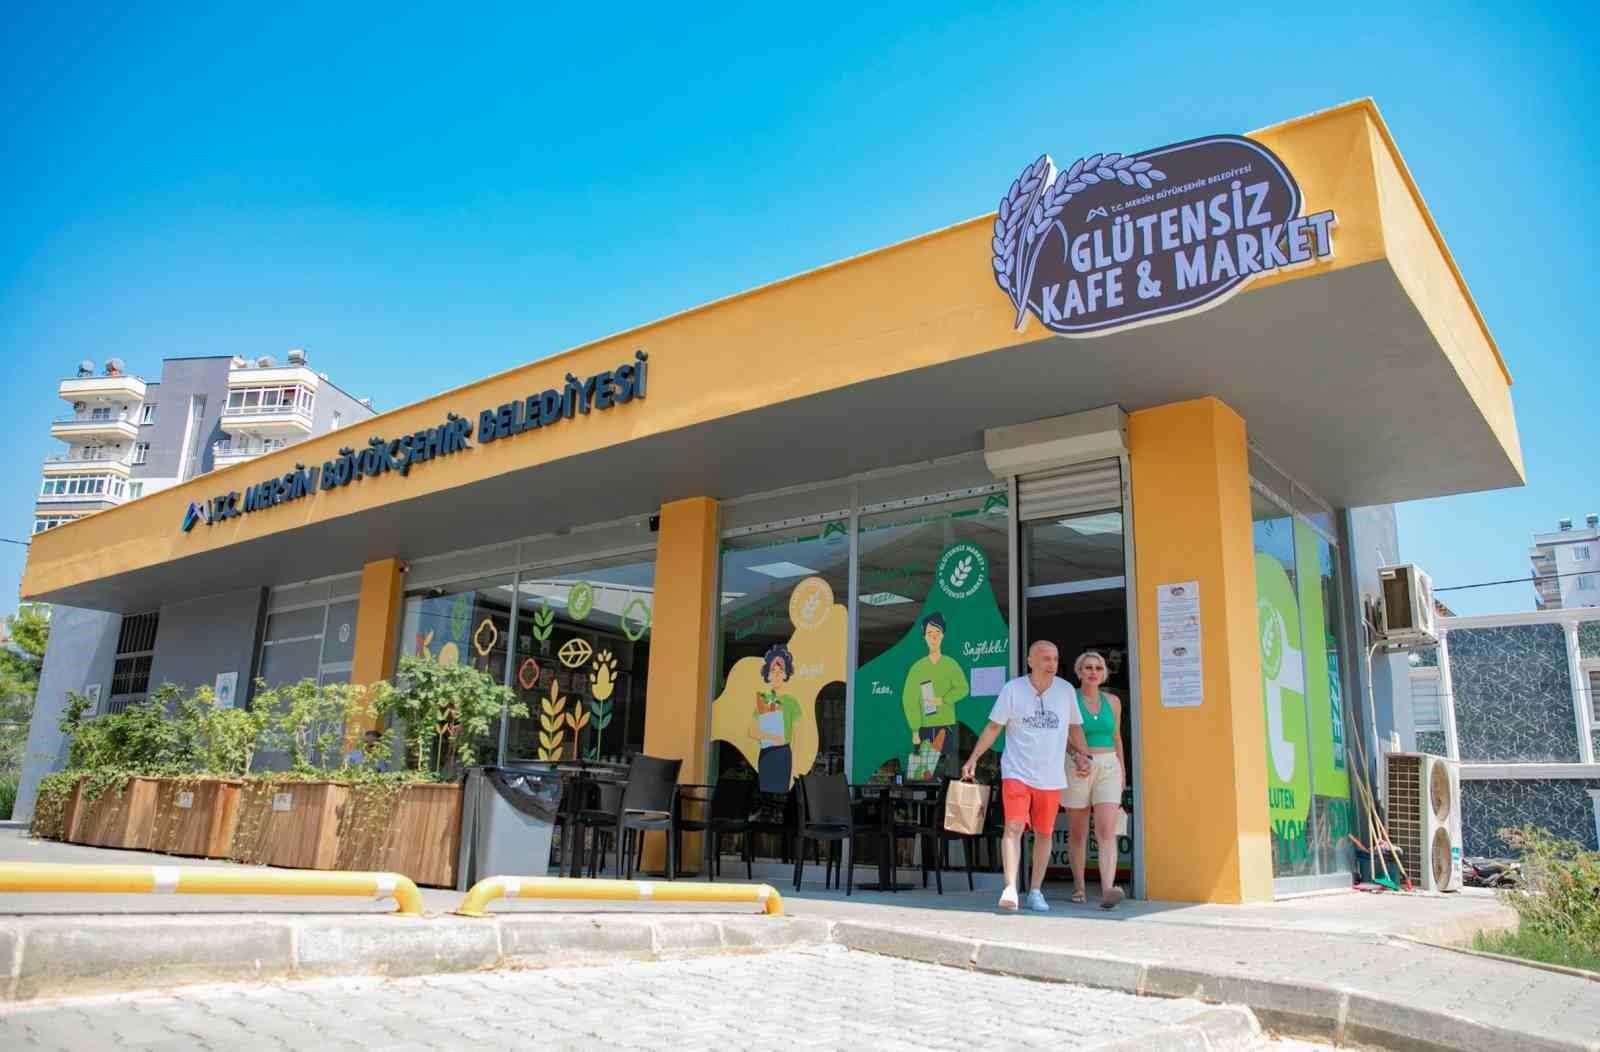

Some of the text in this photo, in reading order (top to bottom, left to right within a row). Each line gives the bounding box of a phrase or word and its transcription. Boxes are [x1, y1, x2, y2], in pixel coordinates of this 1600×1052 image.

[1042, 210, 1335, 324] KAFE & MARKET
[1071, 180, 1272, 272] GLÜTENSİZ
[241, 463, 320, 512] MERSİN
[321, 411, 472, 491] BÜYÜKŞEHİR
[478, 350, 648, 443] BELEDİYESİ
